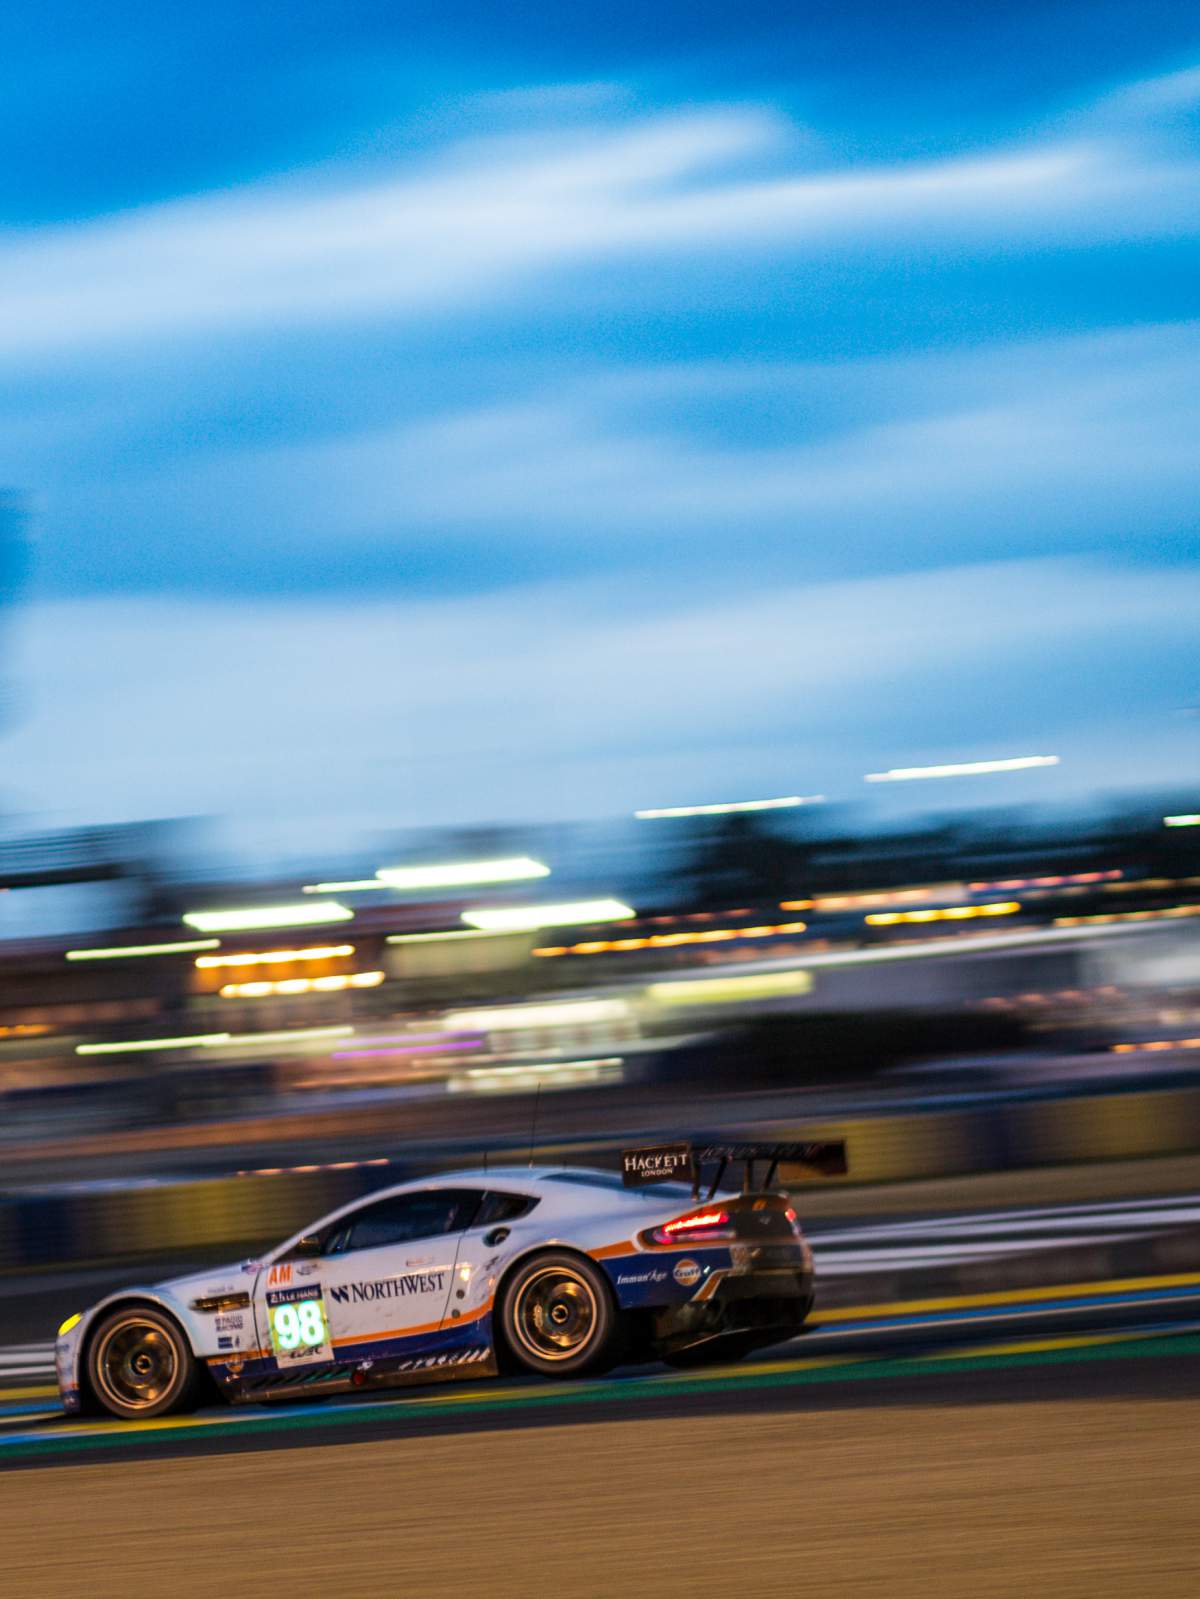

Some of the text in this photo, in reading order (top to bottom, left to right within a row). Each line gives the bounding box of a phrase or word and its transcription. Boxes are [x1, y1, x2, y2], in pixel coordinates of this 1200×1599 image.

[624, 1154, 687, 1171] HACKETT
[641, 1168, 674, 1178] LONDON
[269, 1264, 292, 1285] AM
[273, 1300, 325, 1350] 98
